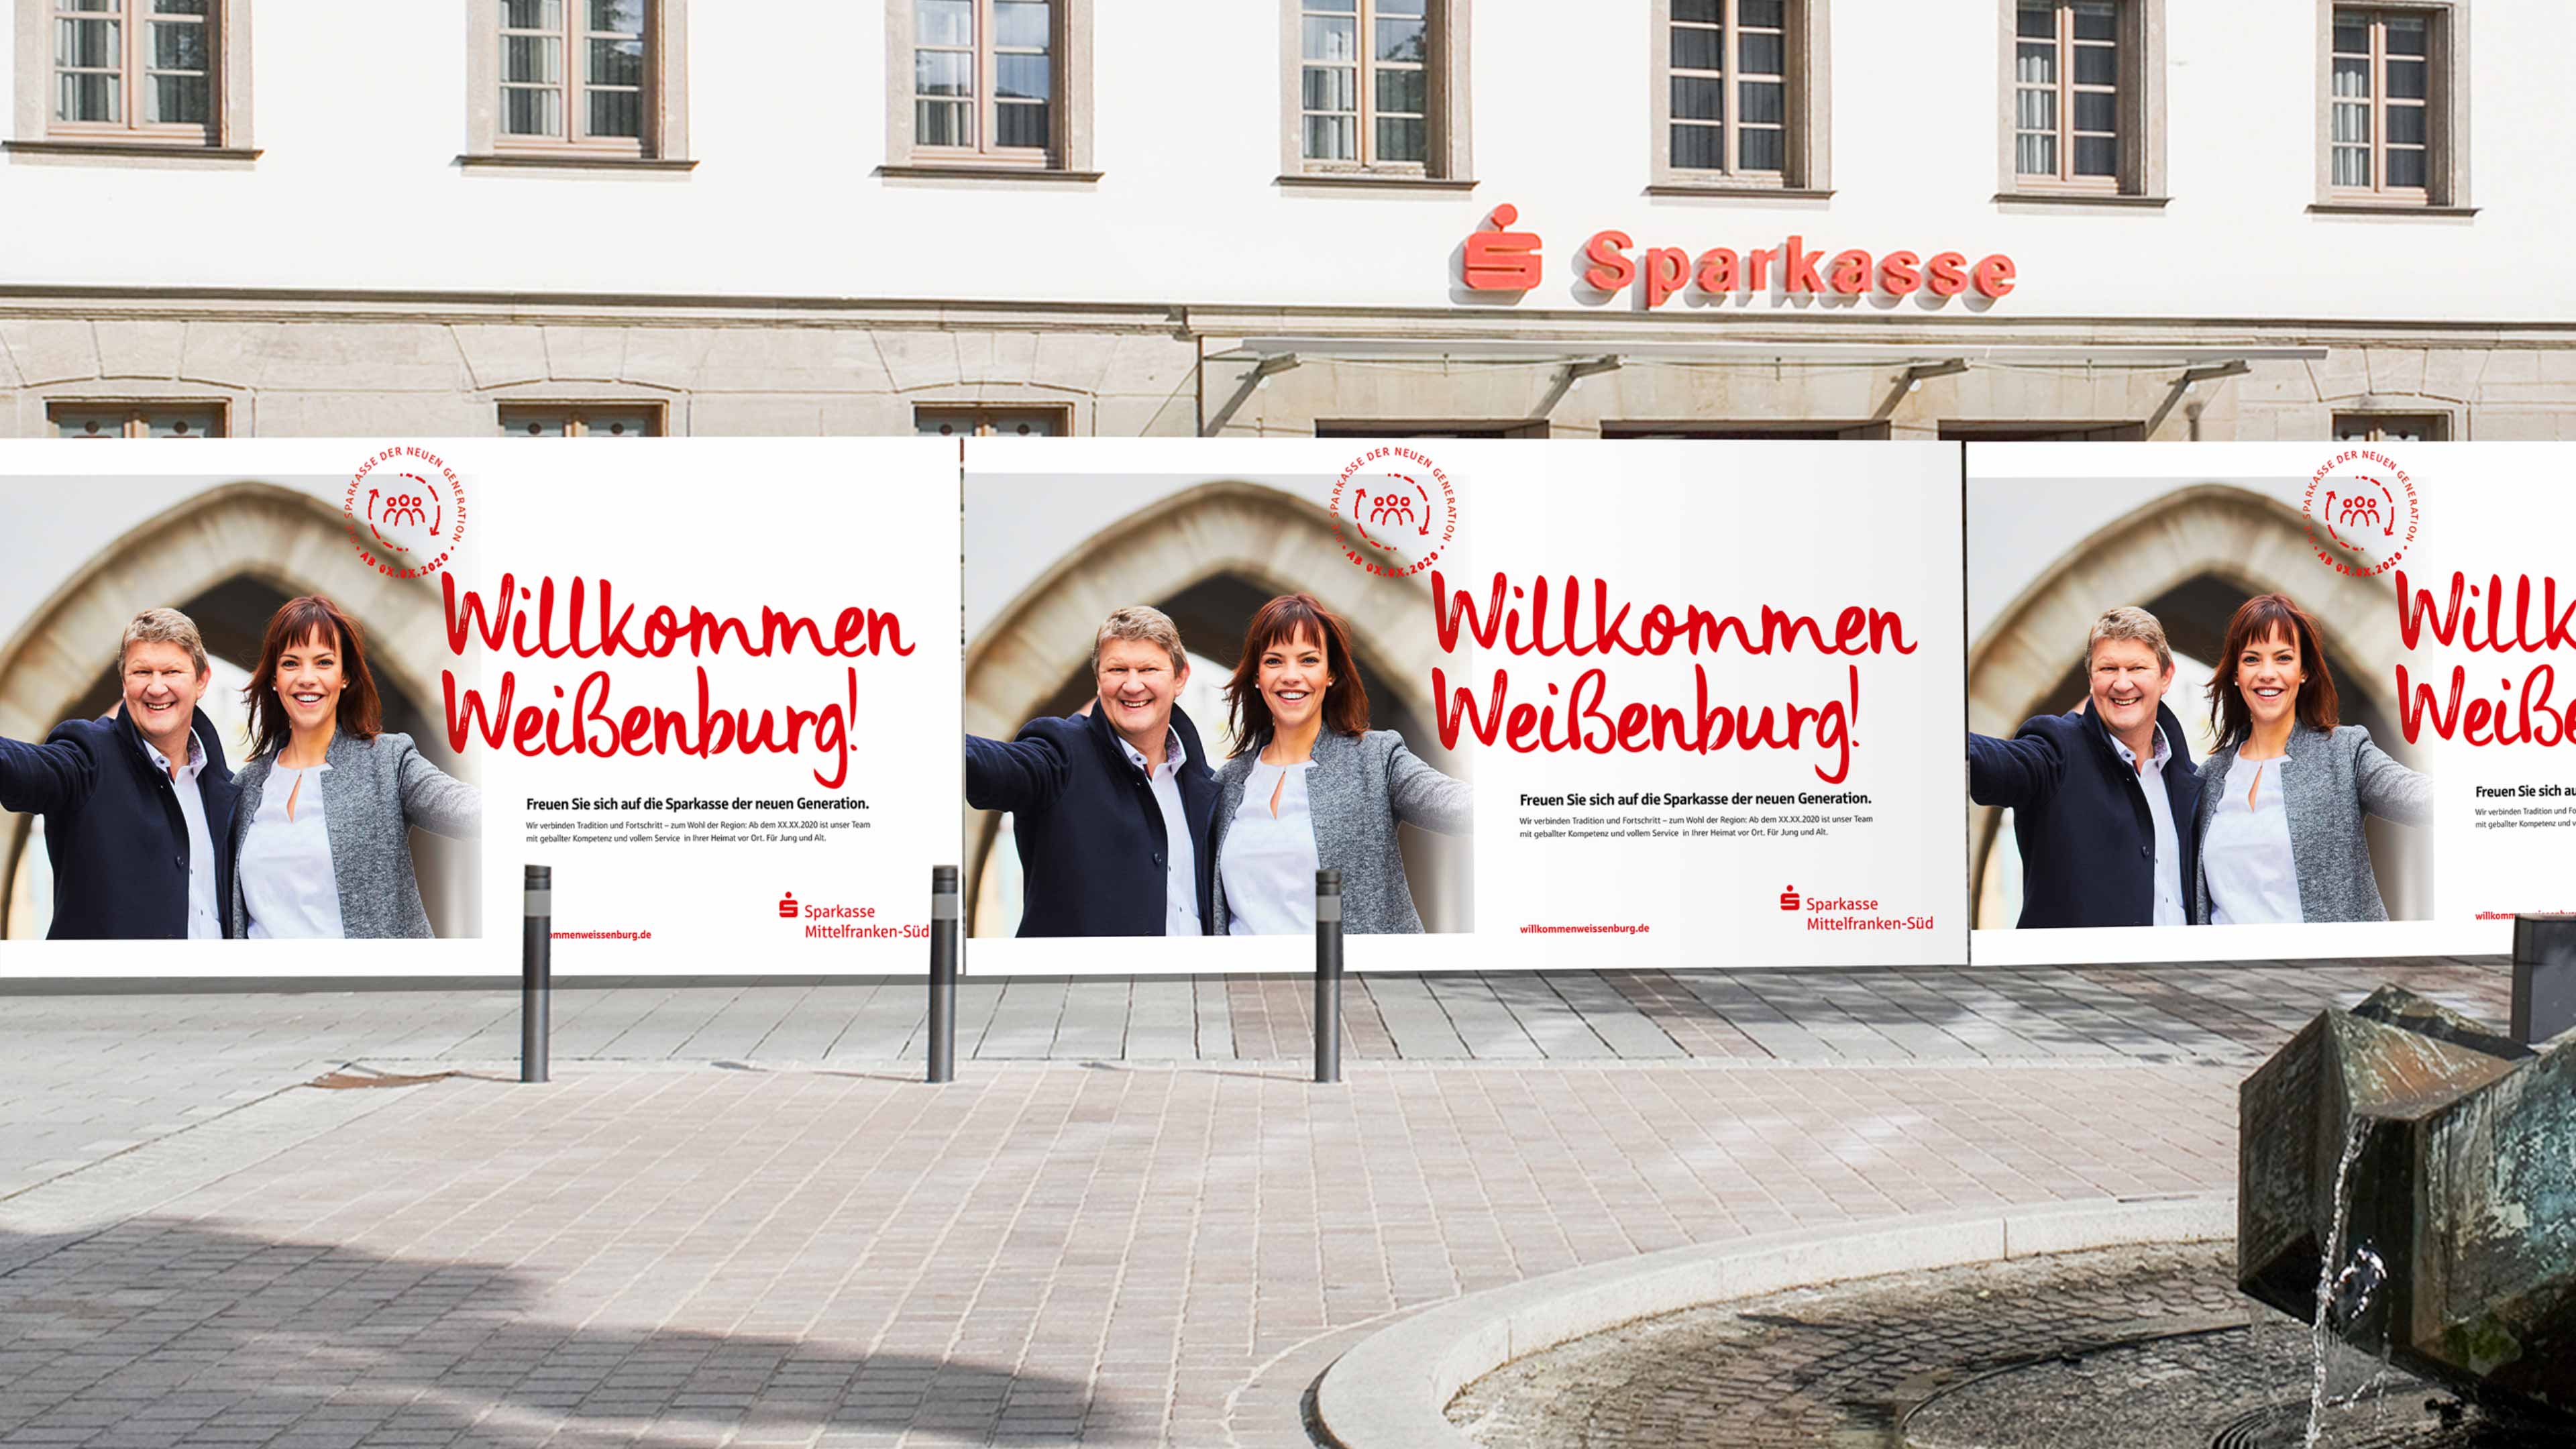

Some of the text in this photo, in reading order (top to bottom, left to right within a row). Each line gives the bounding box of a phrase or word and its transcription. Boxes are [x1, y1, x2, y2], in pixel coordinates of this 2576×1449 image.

[1585, 230, 2016, 307] Sparkasse
[344, 457, 378, 519] SPARKASSE
[380, 447, 402, 461] DER
[407, 447, 443, 468] NEUEN
[443, 468, 466, 542] GENERATION
[1330, 457, 1364, 519] SPARKASSE
[1366, 447, 1390, 461] DER
[1395, 447, 1432, 468] NEUEN
[1433, 468, 1456, 541] GENERATION
[2303, 460, 2334, 519] SPARKASSE
[2337, 450, 2358, 464] DER
[2362, 450, 2397, 470] NEUEN
[2396, 470, 2418, 542] GENERATION
[360, 551, 376, 566] AB
[1346, 551, 1362, 566] AB
[2318, 551, 2333, 566] AB
[441, 571, 916, 658] Willkommen
[1430, 570, 1918, 656] Willkommen
[441, 665, 857, 790] Weißenburg!
[1432, 663, 1859, 784] Weißenburg!
[2476, 786, 2516, 798] Freuen
[2518, 784, 2536, 797] Sie
[2538, 784, 2562, 797] sich
[527, 796, 869, 813] Freuen Sie sich auf die Sparkasse der neuen Generation.
[1520, 791, 1872, 808] Freuen Sie sich auf die Sparkasse der neuen Generation.
[525, 821, 539, 829] Wir
[539, 821, 576, 830] verbinden
[576, 821, 608, 829] Tradition
[610, 821, 624, 829] und
[625, 820, 663, 829] Fortschritt
[687, 820, 706, 829] Wohl
[706, 820, 719, 829] der
[720, 820, 747, 831] Region:
[748, 820, 759, 829] Ab
[759, 820, 776, 829] dem
[777, 820, 818, 829] XX.XX.2020
[851, 820, 871, 828] Team
[1519, 817, 1532, 825] Wir
[1534, 817, 1570, 825] verbinden
[1572, 816, 1605, 825] Tradition
[1606, 816, 1621, 824] und
[1622, 816, 1661, 824] Fortschritt
[1685, 816, 1705, 824] Wohl
[1706, 816, 1719, 824] der
[1720, 816, 1747, 826] Region:
[1748, 816, 1760, 824] Ab
[1760, 815, 1777, 824] dem
[1778, 815, 1820, 824] XX.XX.2020
[1821, 815, 1831, 823] ist
[1854, 814, 1874, 823] Team
[2487, 820, 2518, 830] geballter
[2519, 820, 2557, 828] Kompetenz
[2557, 819, 2571, 827] und
[526, 835, 538, 843] mit
[539, 834, 571, 845] geballter
[572, 835, 612, 843] Kompetenz
[614, 834, 628, 843] und
[629, 834, 653, 843] vollem
[654, 834, 681, 843] Service
[692, 834, 710, 842] Ihrer
[710, 834, 736, 842] Heimat
[750, 834, 765, 842] Ort.
[766, 834, 778, 842] Für
[780, 834, 798, 844] Jung
[798, 833, 813, 842] und
[814, 833, 826, 842] Alt.
[1534, 830, 1566, 840] geballter
[1568, 830, 1609, 839] Kompetenz
[1610, 829, 1625, 837] und
[1626, 829, 1651, 837] vollem
[1652, 829, 1679, 837] Service
[1710, 828, 1736, 837] Heimat
[1751, 828, 1766, 837] Ort.
[1767, 828, 1779, 836] Für
[1780, 828, 1799, 838] Jung
[1800, 828, 1815, 836] und
[1815, 828, 1828, 836] Alt.
[804, 904, 875, 921] Sparkasse
[1807, 897, 1878, 914] Sparkasse
[805, 924, 930, 938] Mittelfranken-Süd
[1519, 924, 1650, 934] willkommenweissenburg.de
[1807, 916, 1934, 931] Mittelfranken-Süd
[549, 930, 652, 941] ommenweissenburg.de
